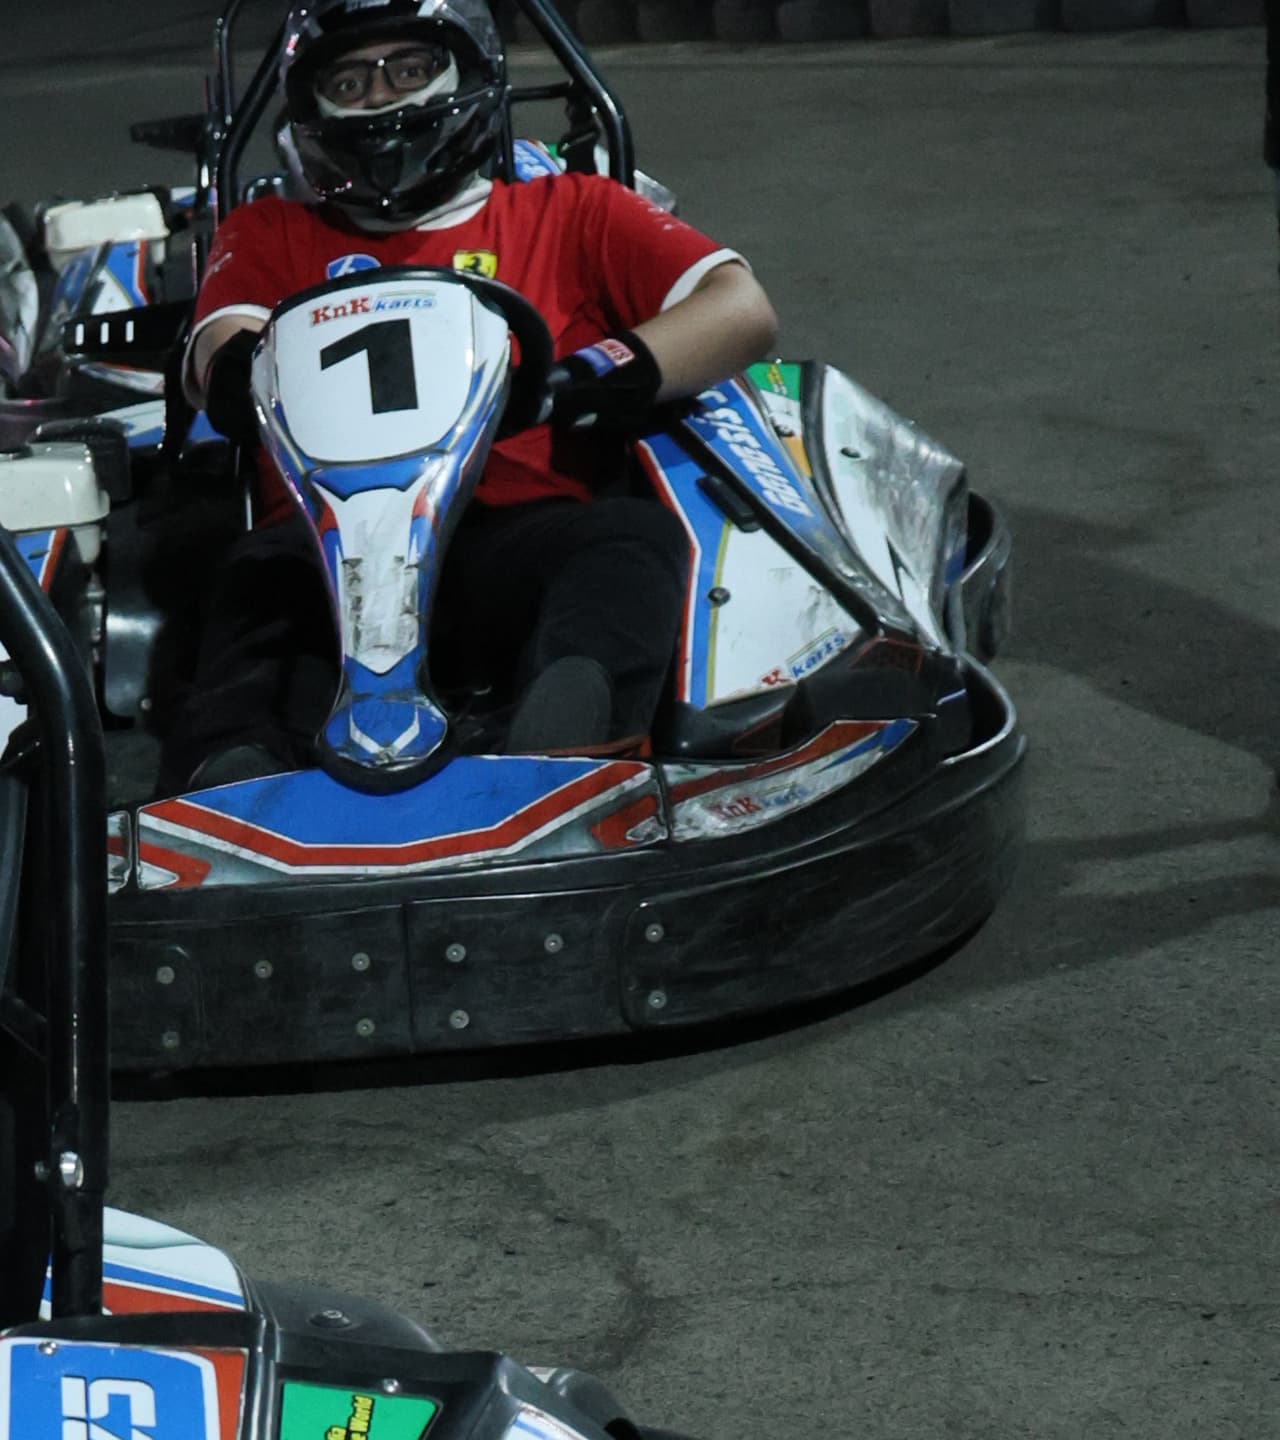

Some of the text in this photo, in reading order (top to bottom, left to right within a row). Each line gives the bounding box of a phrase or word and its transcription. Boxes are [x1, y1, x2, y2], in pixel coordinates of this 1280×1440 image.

[311, 295, 434, 326] KnK karts
[320, 318, 419, 415] 1
[348, 1394, 374, 1432] World
